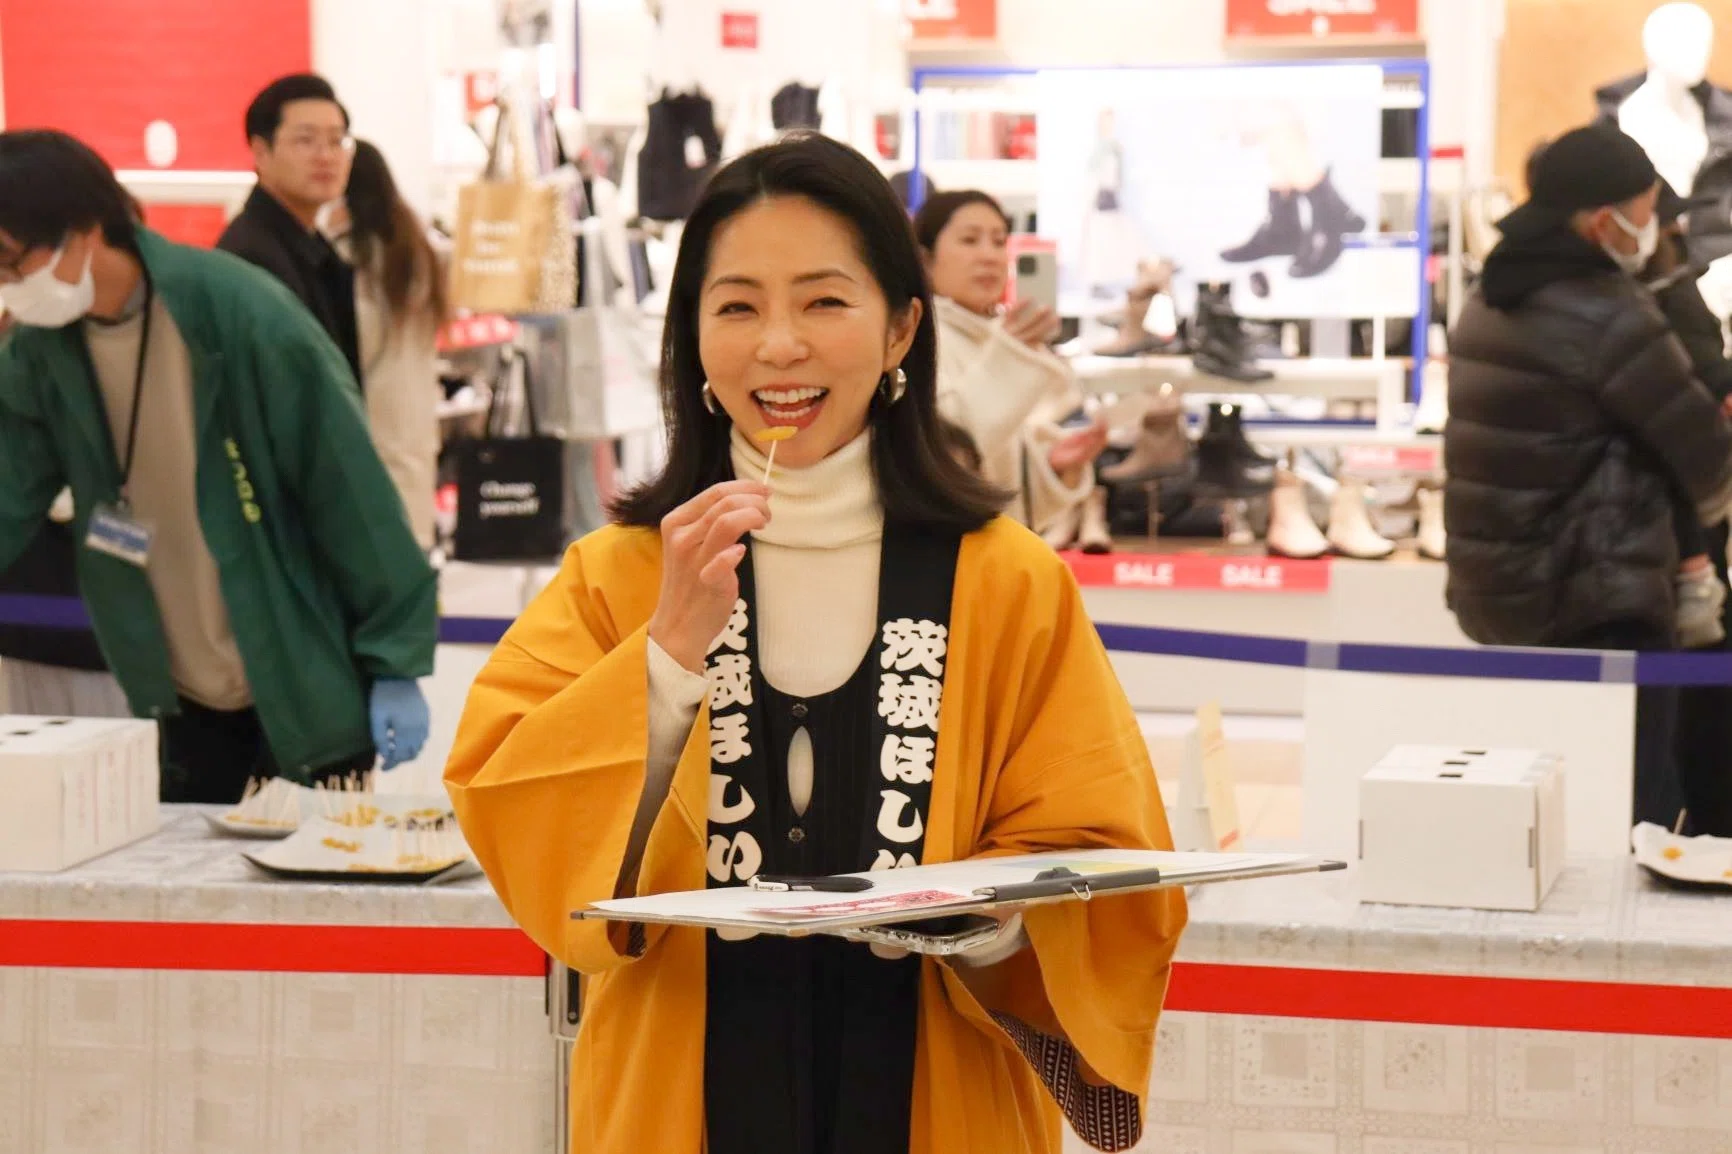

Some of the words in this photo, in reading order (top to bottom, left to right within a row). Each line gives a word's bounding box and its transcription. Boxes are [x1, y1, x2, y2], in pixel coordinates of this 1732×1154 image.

[1114, 562, 1174, 584] SALE
[1221, 564, 1282, 587] SALE
[704, 597, 763, 940] 城ほしい
